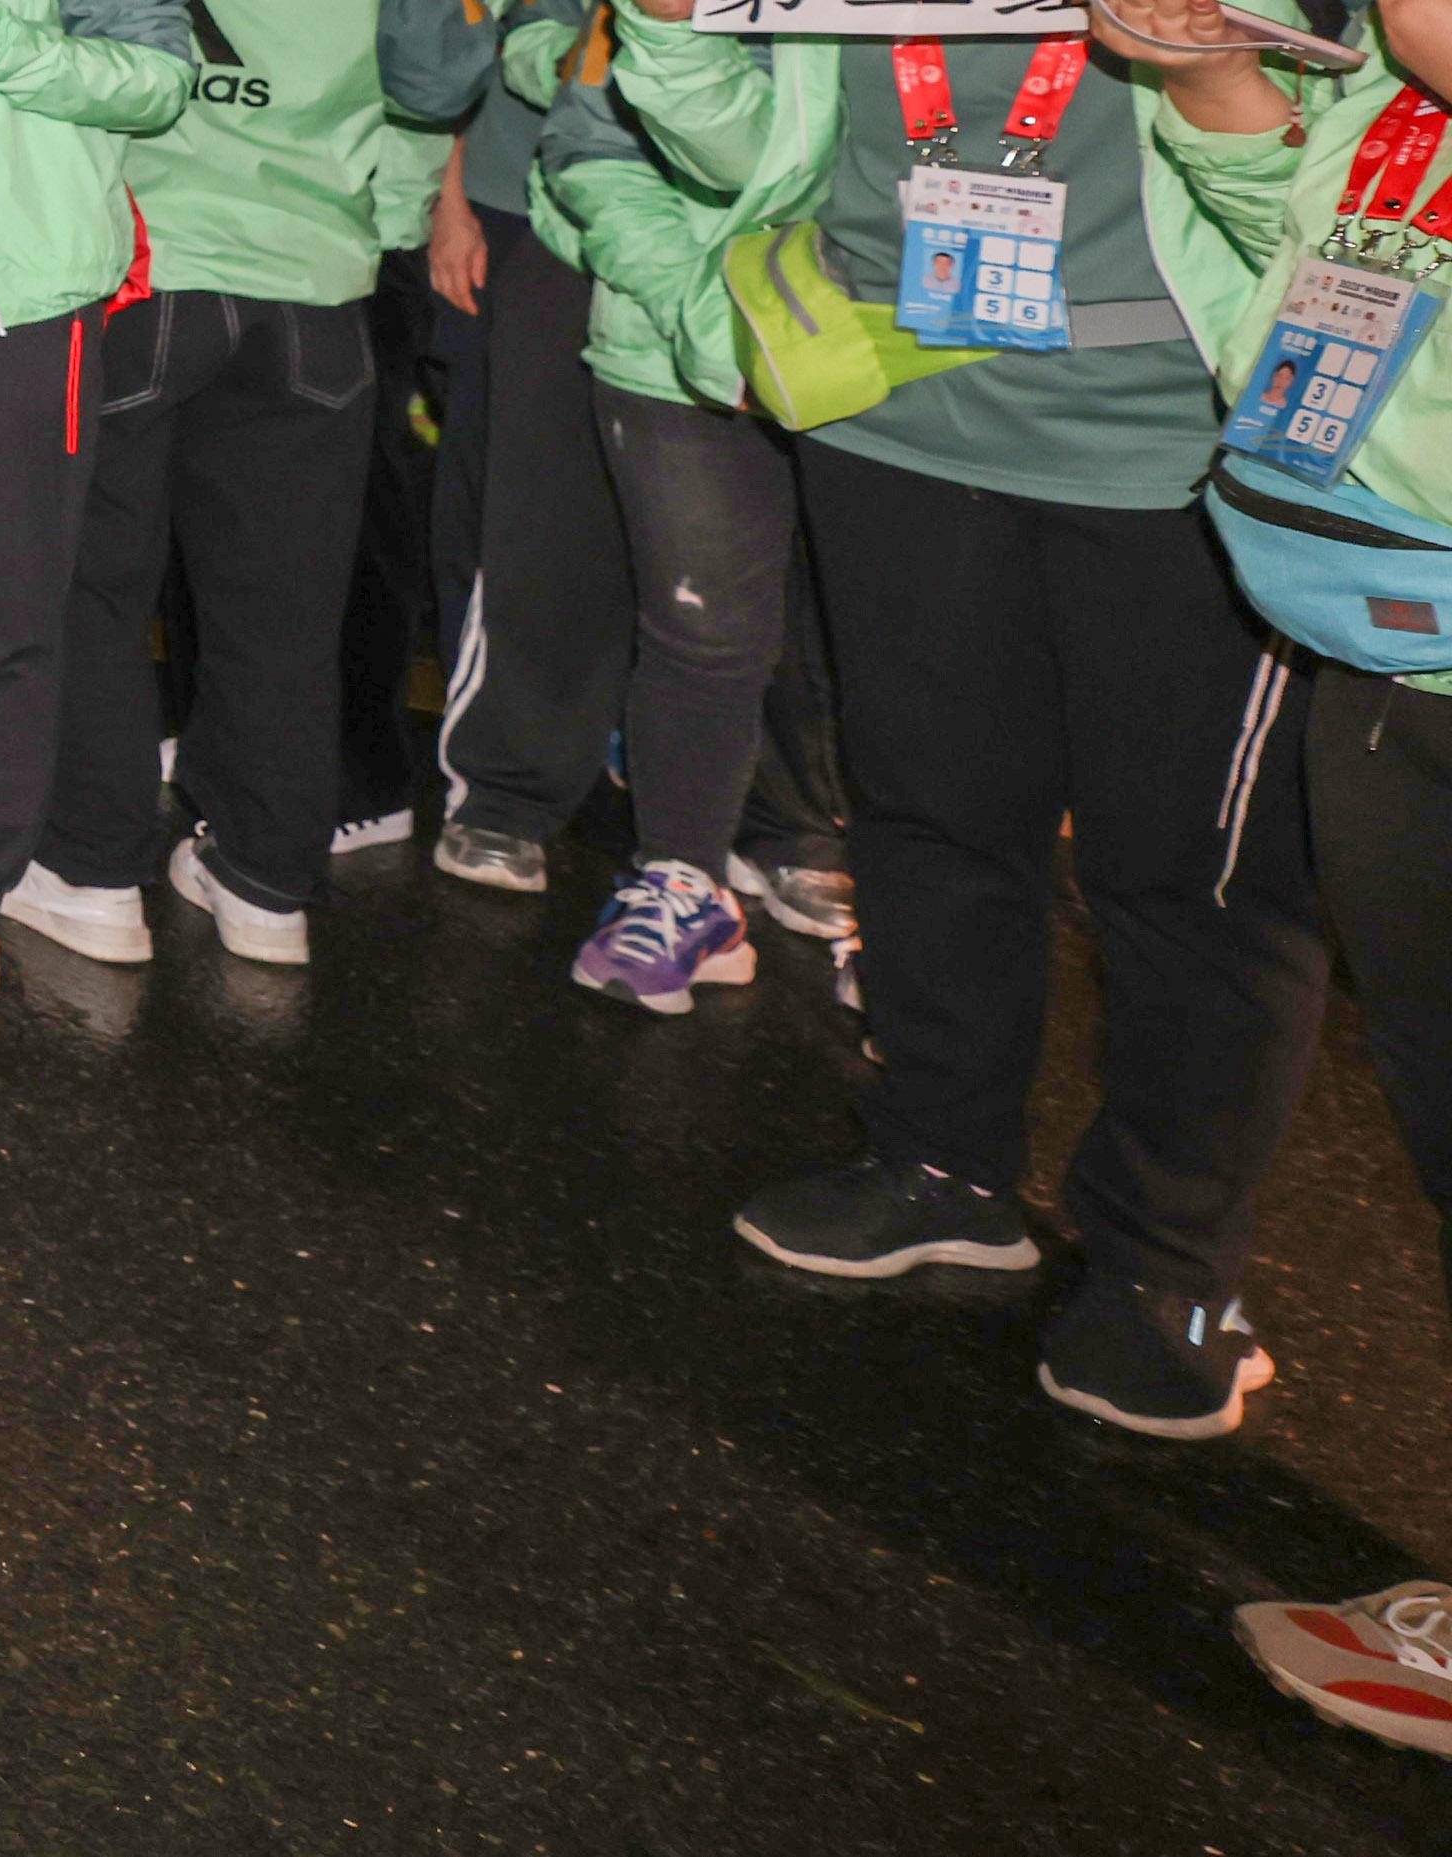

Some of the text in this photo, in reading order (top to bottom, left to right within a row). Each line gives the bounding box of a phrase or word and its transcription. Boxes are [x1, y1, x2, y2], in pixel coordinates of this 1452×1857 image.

[989, 270, 1003, 286] 3
[986, 299, 1037, 320] 5 6
[1313, 383, 1328, 400] 3
[1298, 416, 1338, 442] 5 6
